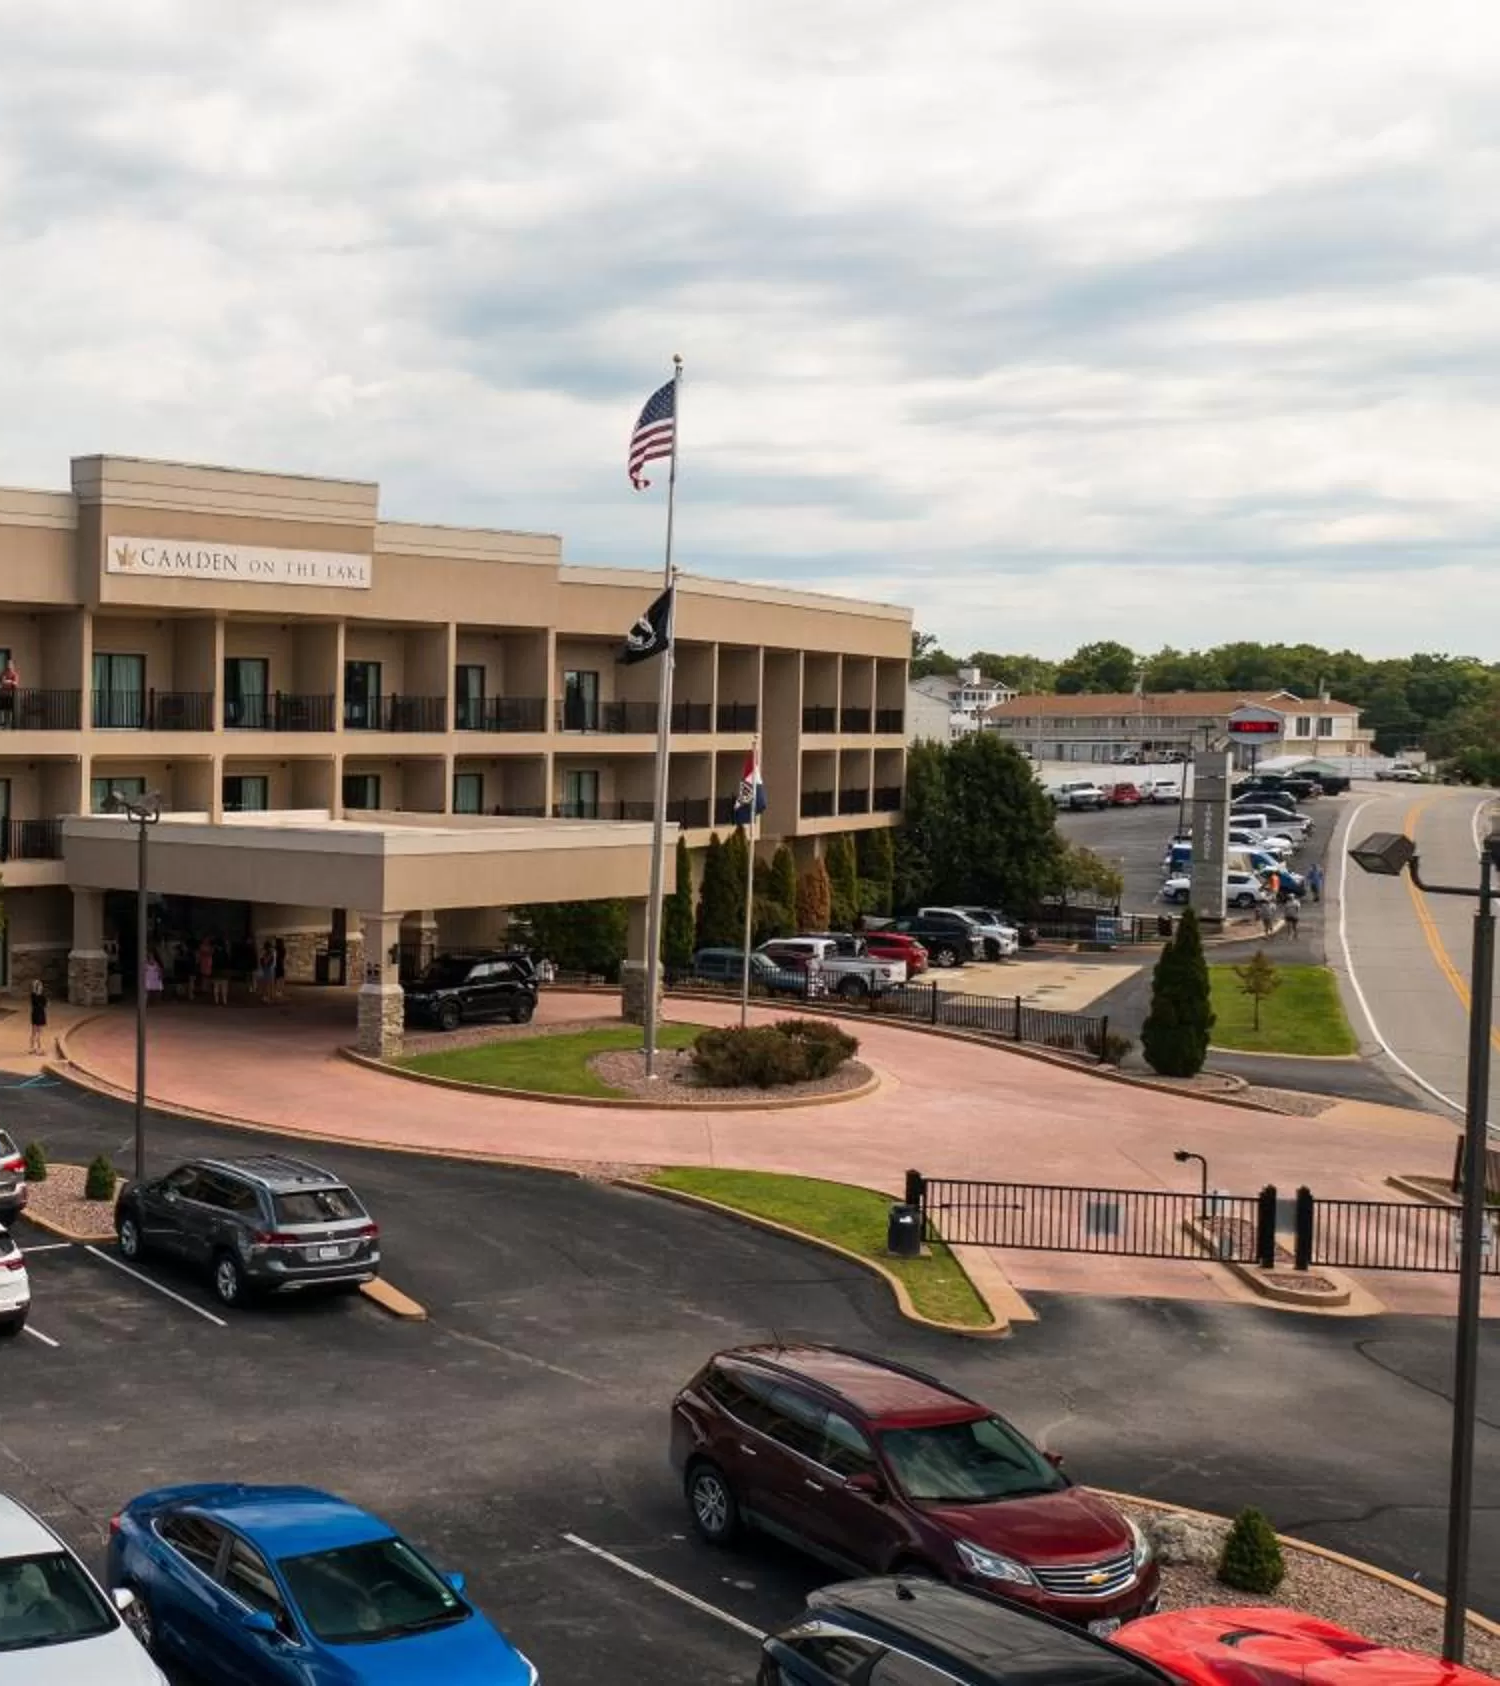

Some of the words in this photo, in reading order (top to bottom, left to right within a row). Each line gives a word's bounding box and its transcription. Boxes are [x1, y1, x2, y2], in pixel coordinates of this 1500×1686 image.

[141, 547, 238, 571] CAMDEN
[248, 559, 275, 574] ON
[285, 561, 316, 577] THE
[326, 563, 366, 580] LAKE
